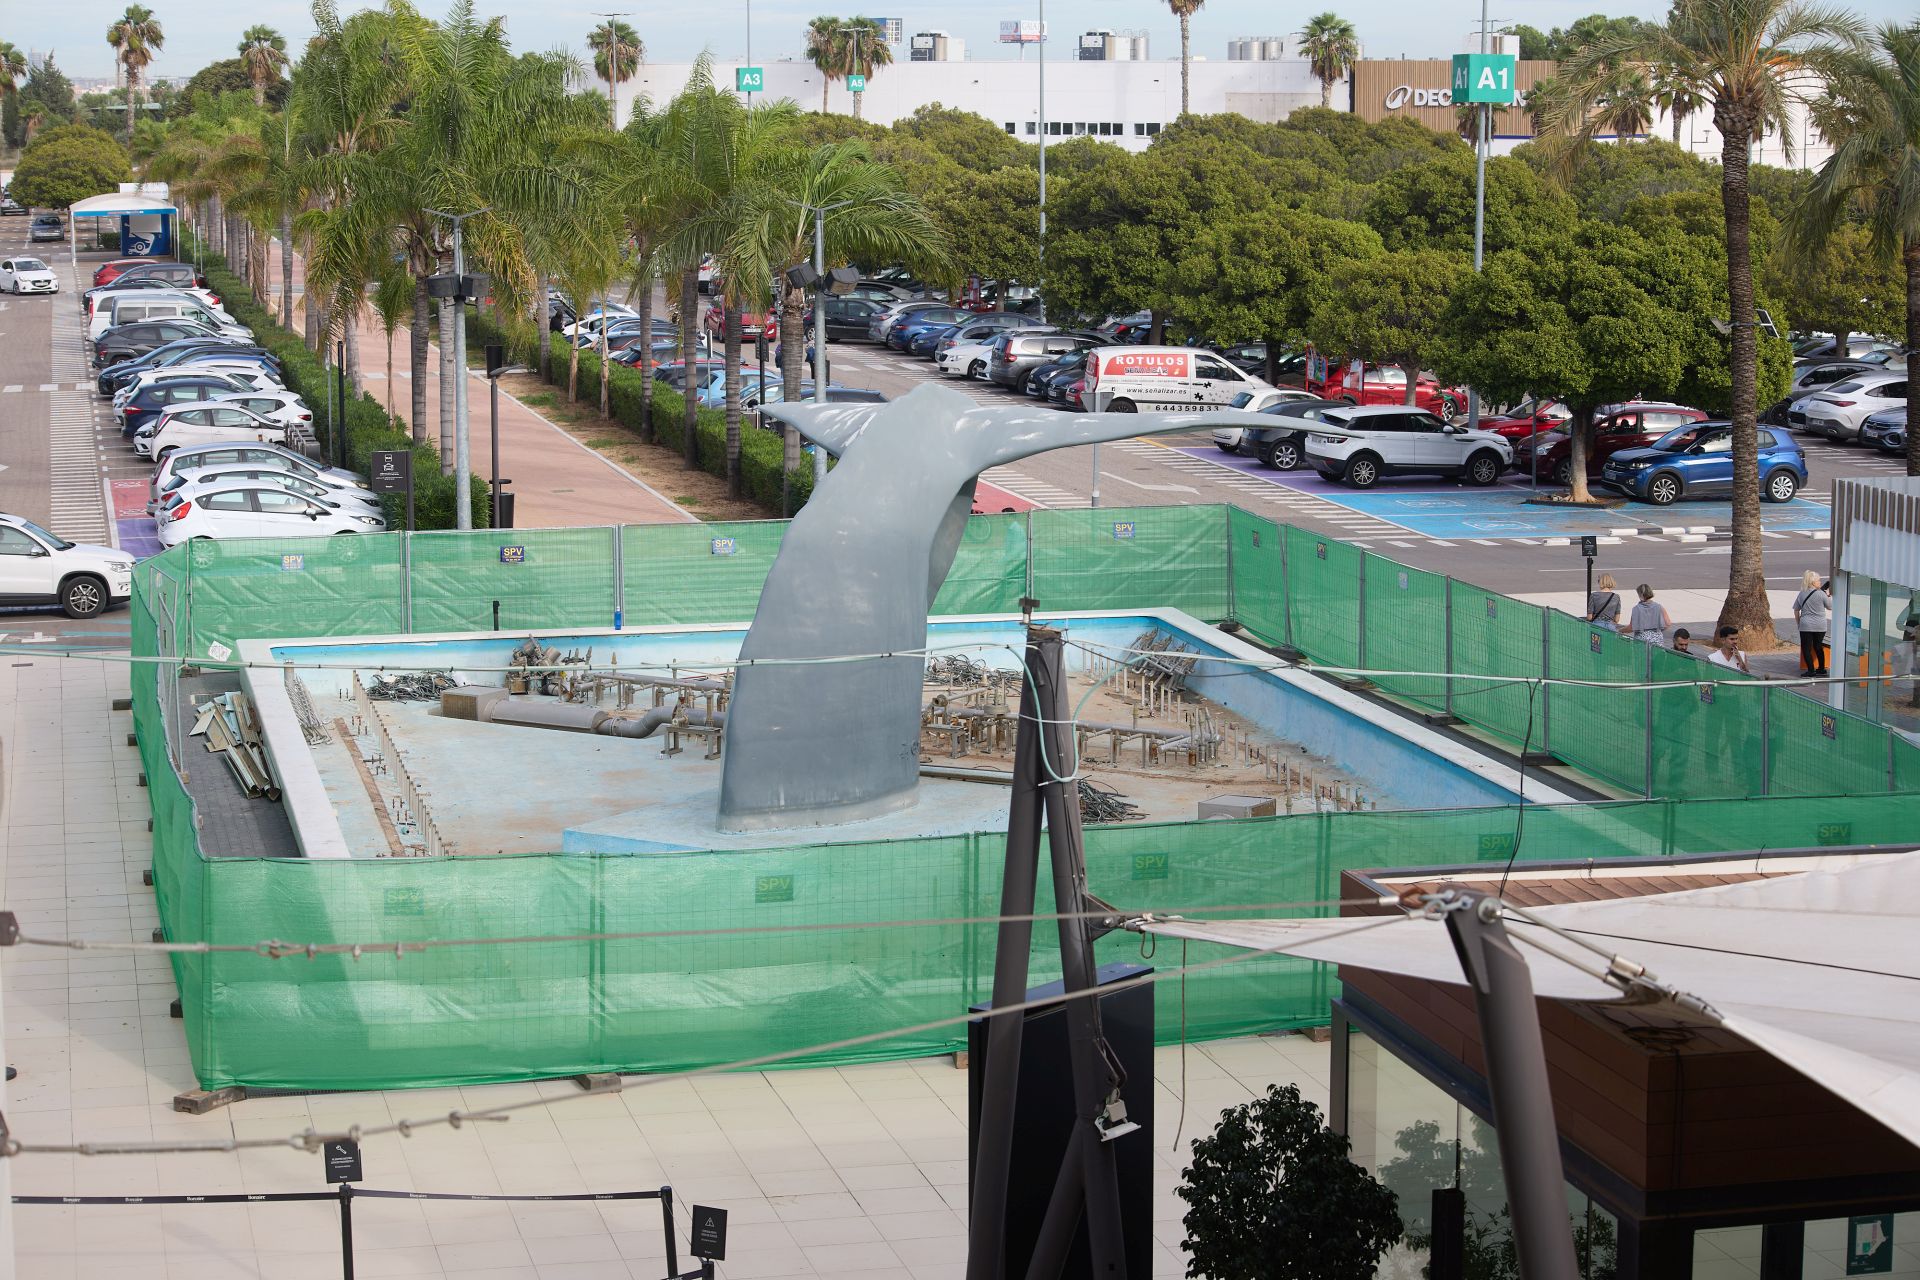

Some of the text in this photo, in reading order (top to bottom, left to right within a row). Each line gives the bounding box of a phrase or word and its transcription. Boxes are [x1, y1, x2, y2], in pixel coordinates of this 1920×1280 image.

[742, 73, 761, 86] A3
[1454, 66, 1468, 89] A1
[1477, 66, 1508, 90] A1
[850, 80, 863, 88] A5
[1116, 356, 1185, 366] ROTULOS
[1126, 387, 1187, 395] www.señalizar.es
[1155, 404, 1219, 412] 644359833
[1115, 523, 1134, 532] SPV
[715, 539, 734, 548] SPV
[503, 547, 523, 556] SPV
[283, 555, 303, 564] SPV
[1823, 715, 1835, 729] SPV
[1820, 824, 1849, 838] SPV
[1482, 836, 1511, 849] SPV
[1135, 855, 1166, 869] SPV
[758, 877, 790, 891] SPV
